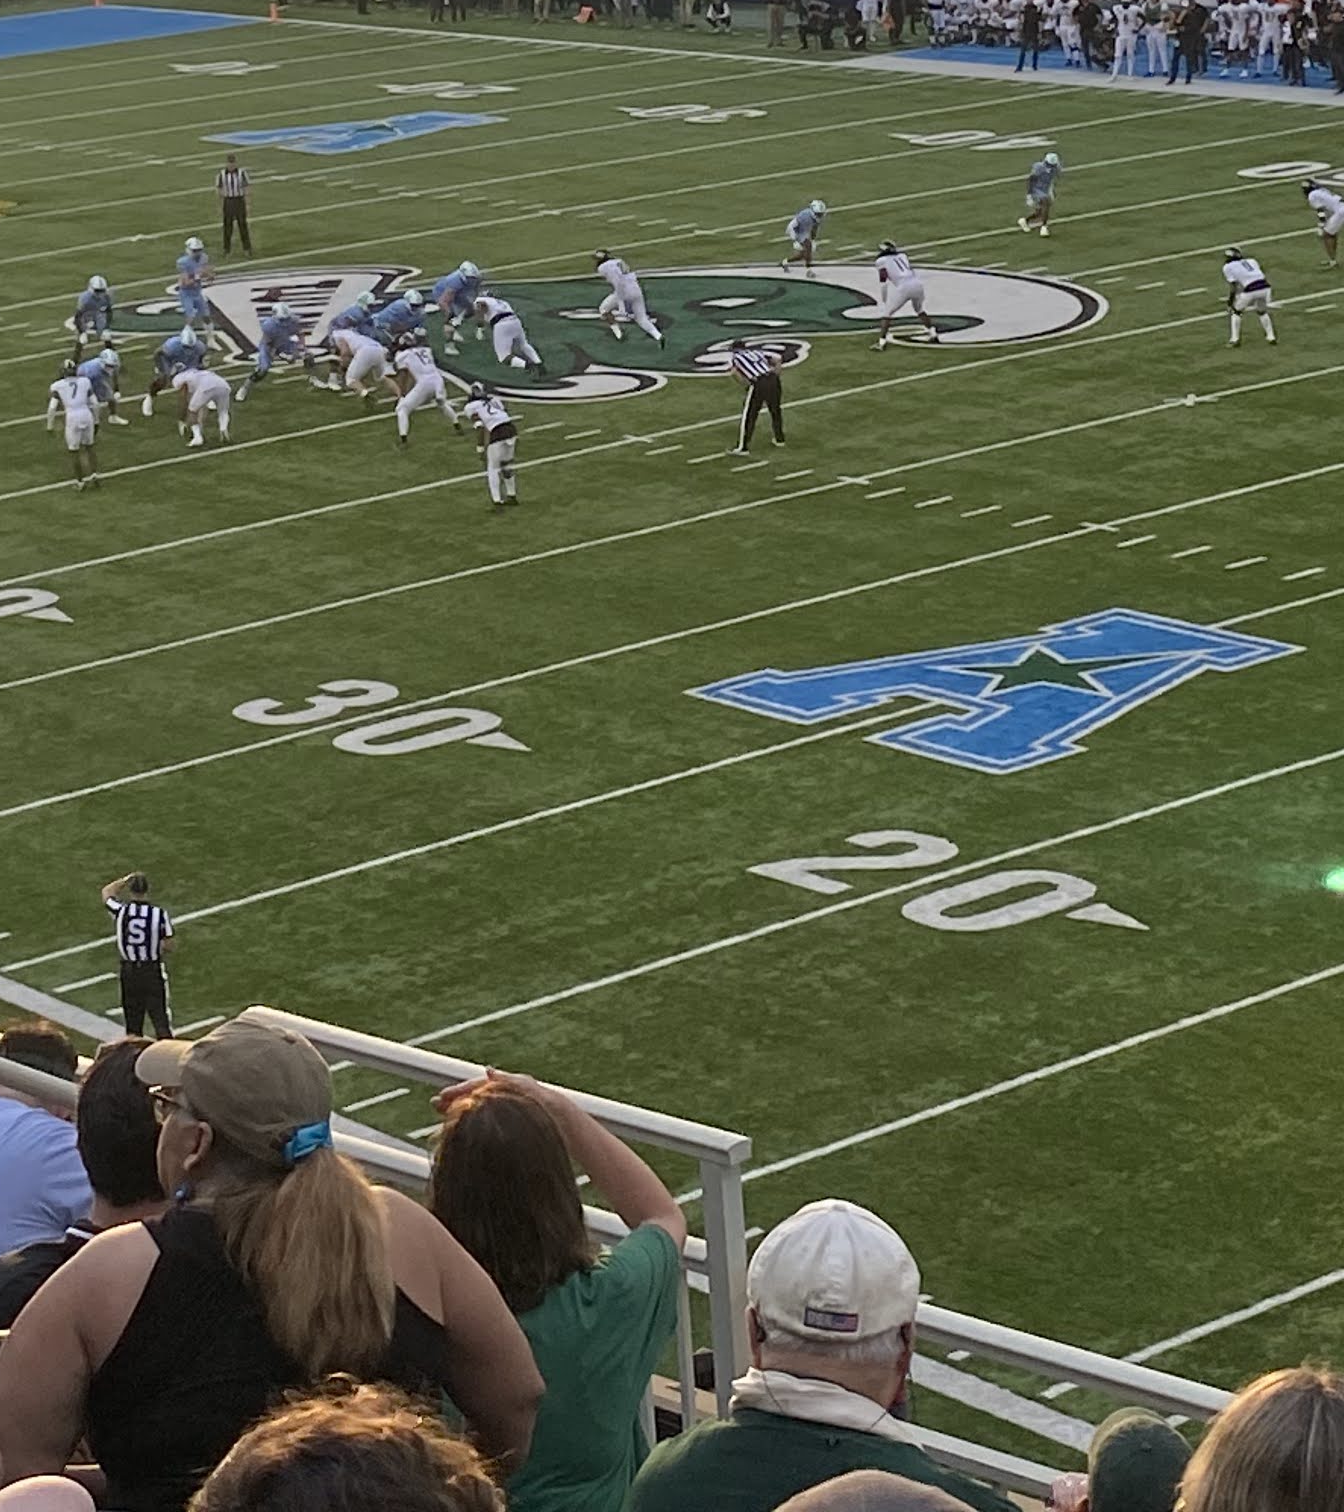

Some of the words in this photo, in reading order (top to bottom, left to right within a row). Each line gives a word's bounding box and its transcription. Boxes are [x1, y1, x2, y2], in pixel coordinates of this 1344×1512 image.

[69, 382, 77, 399] 7
[232, 680, 502, 755] 30
[745, 830, 1097, 930] 20
[128, 918, 146, 944] S
